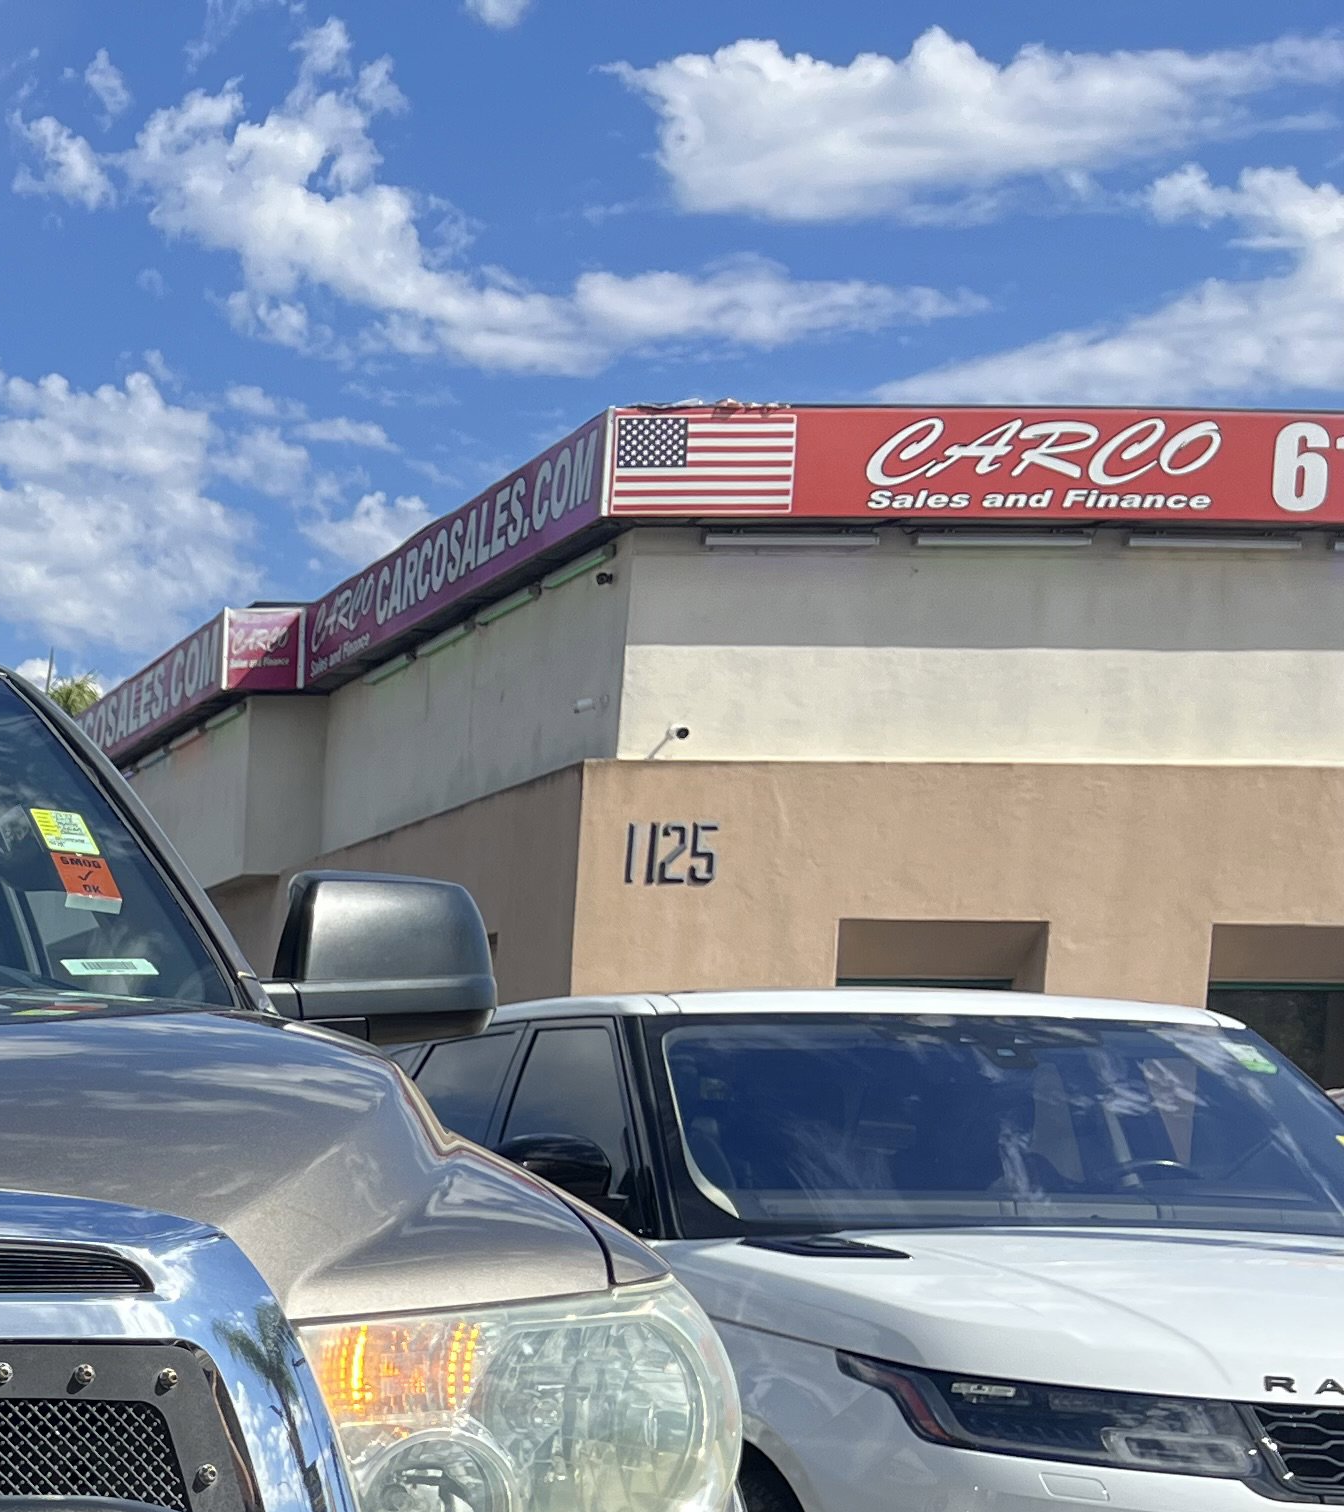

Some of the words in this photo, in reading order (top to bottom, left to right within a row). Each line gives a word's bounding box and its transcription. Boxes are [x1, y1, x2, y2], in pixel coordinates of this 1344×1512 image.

[865, 416, 1222, 486] CARCO
[1272, 421, 1344, 511] 6
[375, 428, 598, 625] CARCOSALES.COM
[866, 488, 971, 510] Sales
[982, 488, 1051, 510] and
[1061, 489, 1212, 510] Finance
[60, 856, 102, 870] SMOG
[623, 821, 720, 887] 1125
[82, 883, 103, 895] OK
